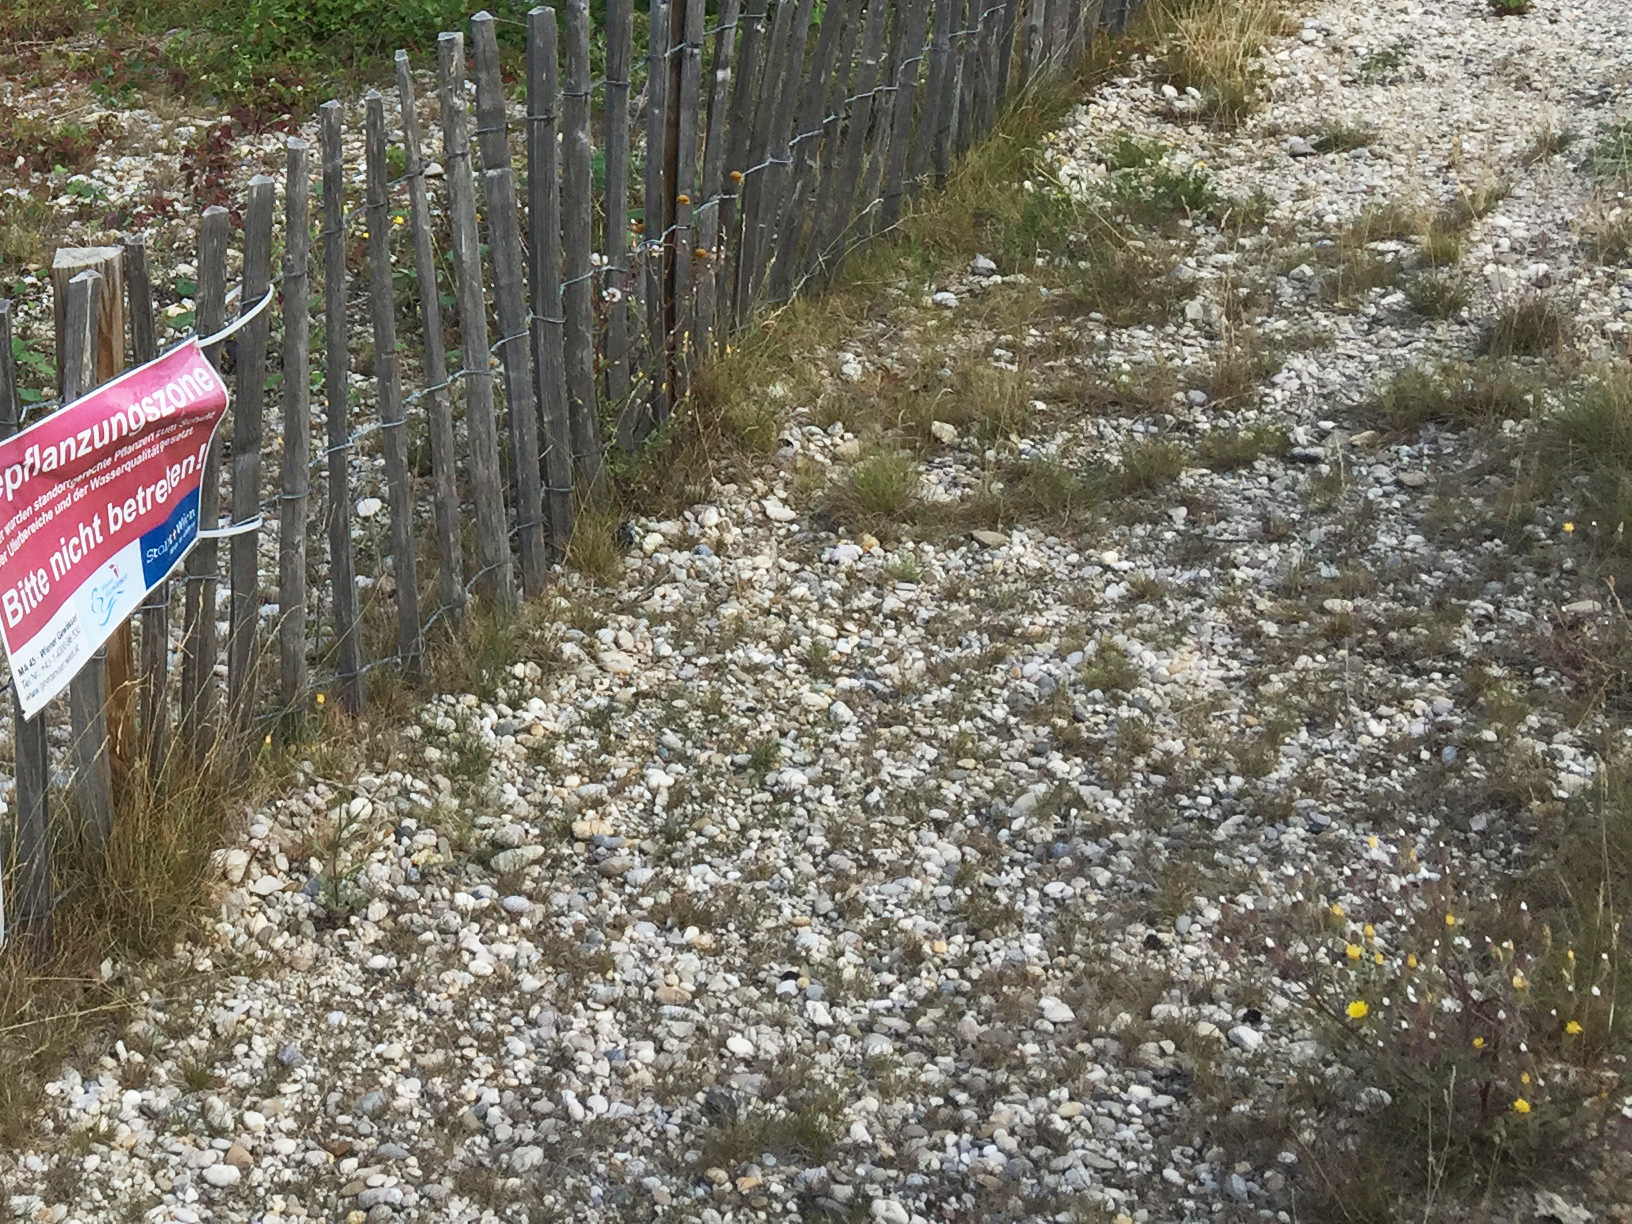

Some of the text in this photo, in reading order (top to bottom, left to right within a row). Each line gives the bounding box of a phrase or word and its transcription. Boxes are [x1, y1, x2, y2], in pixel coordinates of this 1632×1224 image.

[1, 567, 50, 629] Bitte
[49, 513, 104, 582] nicht
[107, 443, 207, 535] betreten!
[3, 505, 33, 535] wurden
[113, 431, 155, 462] Pflanzen
[6, 509, 54, 557] Uferbereiche
[54, 494, 72, 516] und
[73, 484, 89, 501] der
[89, 442, 160, 491] Wasserqualität
